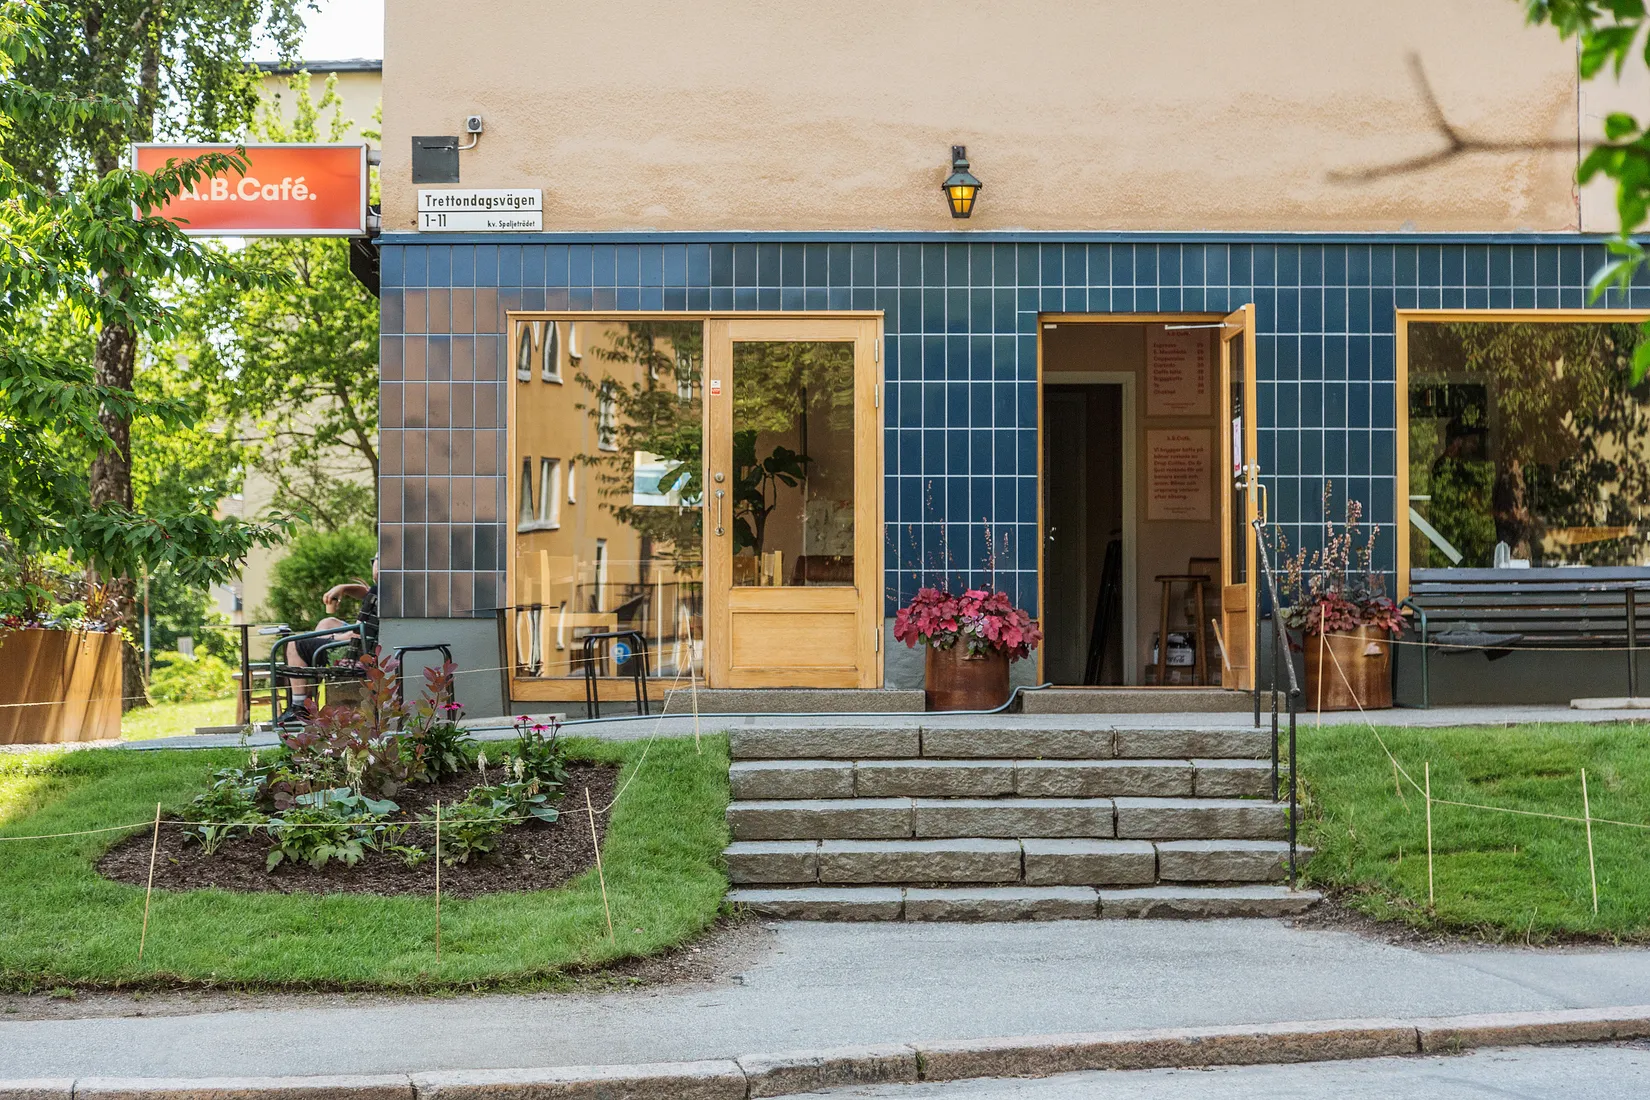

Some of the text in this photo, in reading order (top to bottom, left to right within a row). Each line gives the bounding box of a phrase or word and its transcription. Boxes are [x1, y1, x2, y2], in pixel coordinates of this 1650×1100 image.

[425, 194, 535, 209] Trettondagsvägen
[425, 214, 446, 227] 1-11
[487, 220, 498, 228] kv.
